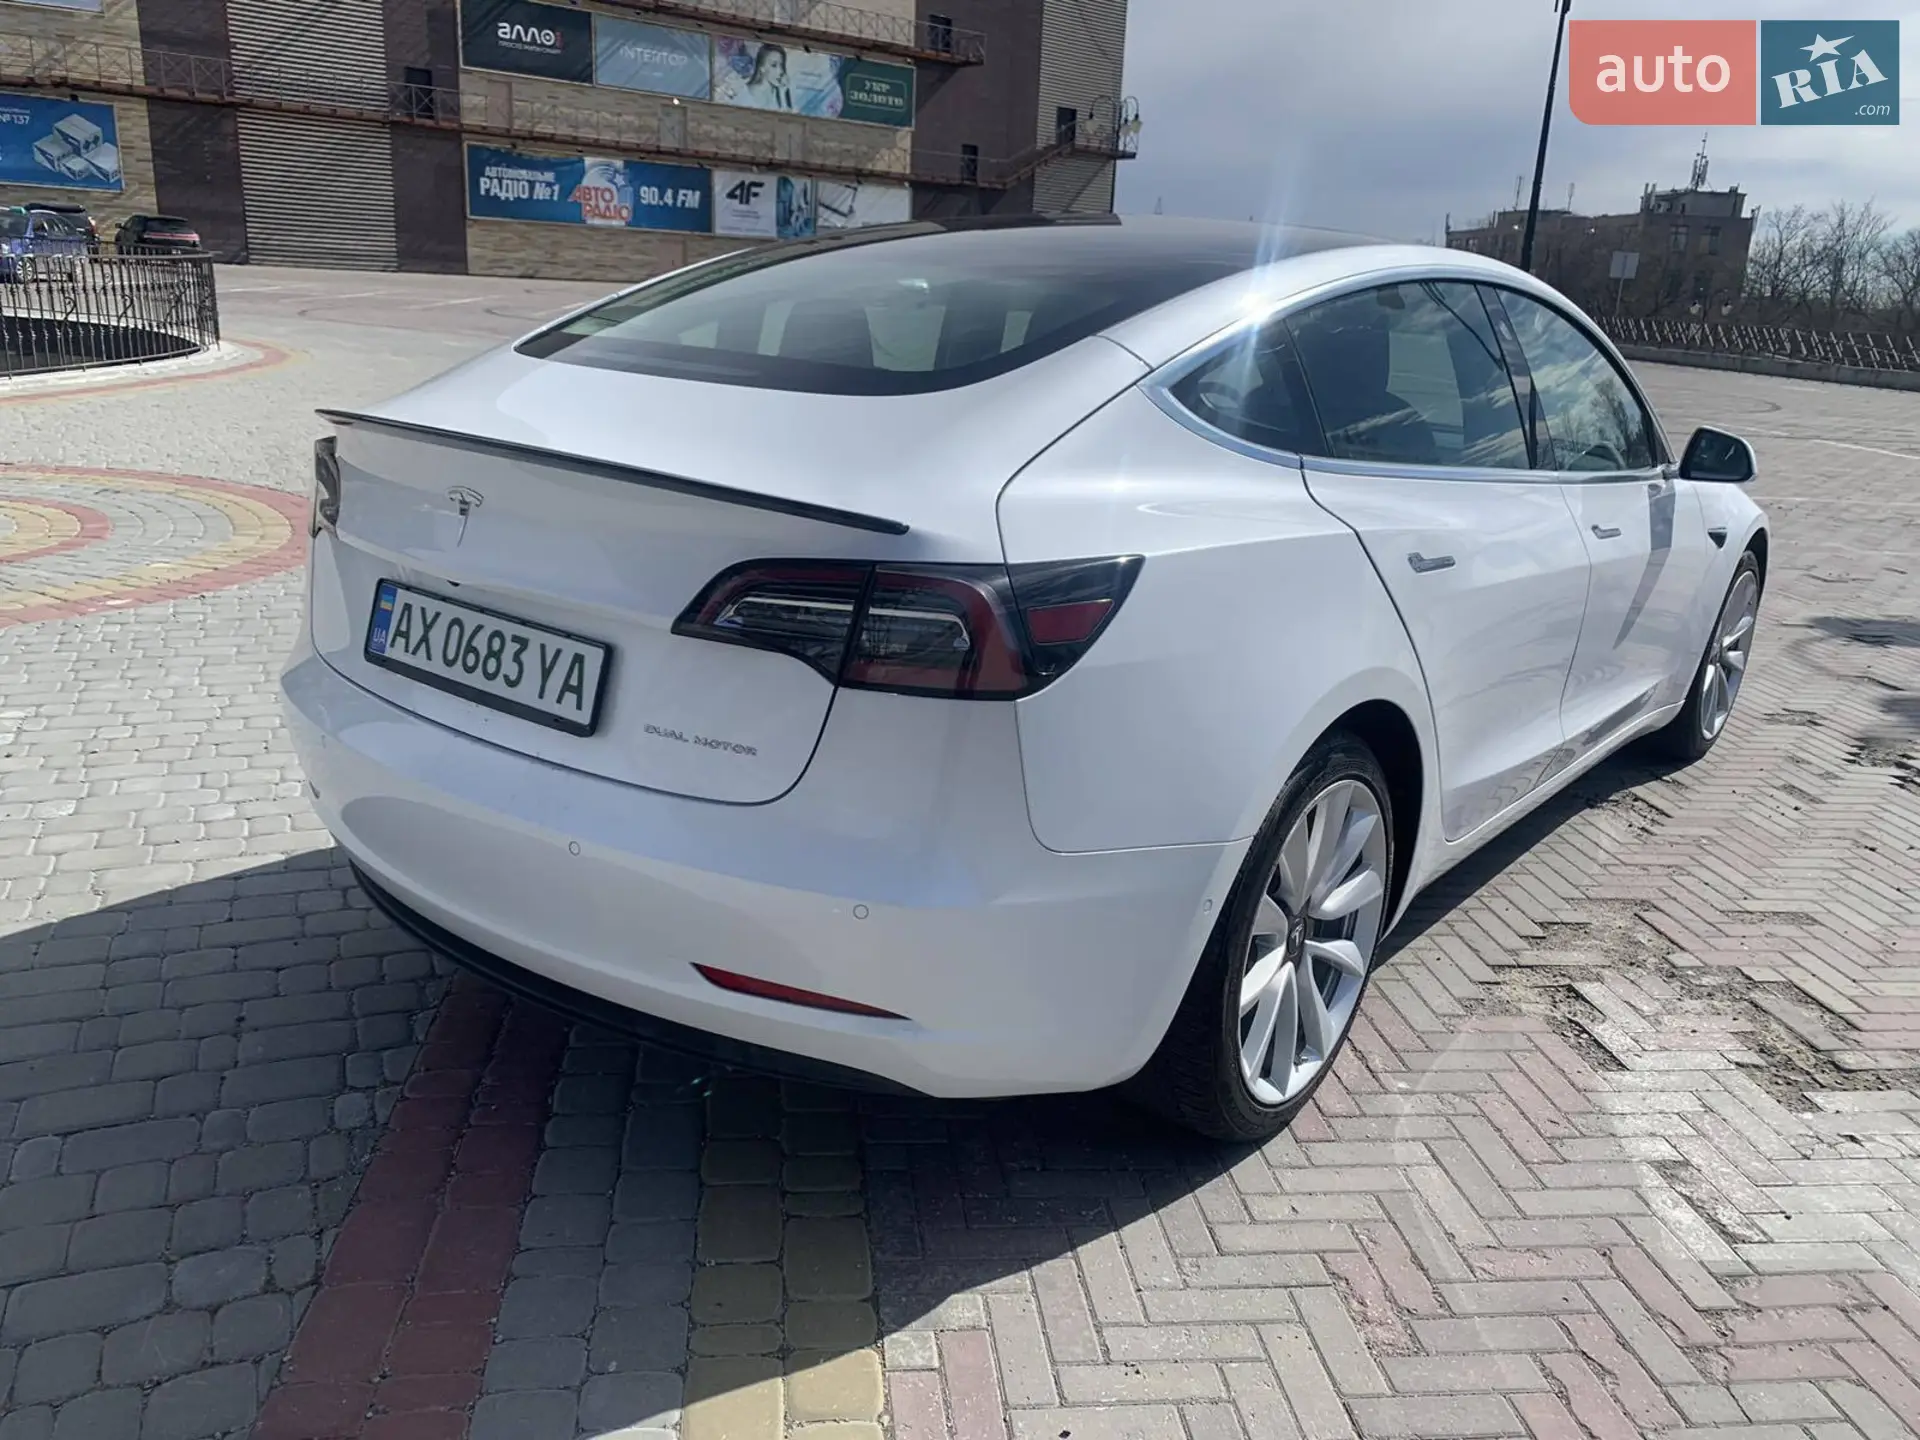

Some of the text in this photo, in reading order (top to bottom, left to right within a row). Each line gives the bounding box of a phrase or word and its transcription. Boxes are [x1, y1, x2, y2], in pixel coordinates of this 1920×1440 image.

[480, 177, 530, 201] РАДІО
[569, 184, 614, 203] АВТО
[640, 186, 700, 208] 90.4 FM
[725, 180, 765, 205] 4F
[582, 203, 631, 221] РАДІО
[372, 627, 387, 645] UA
[643, 723, 758, 756] DUAL MOTOR
